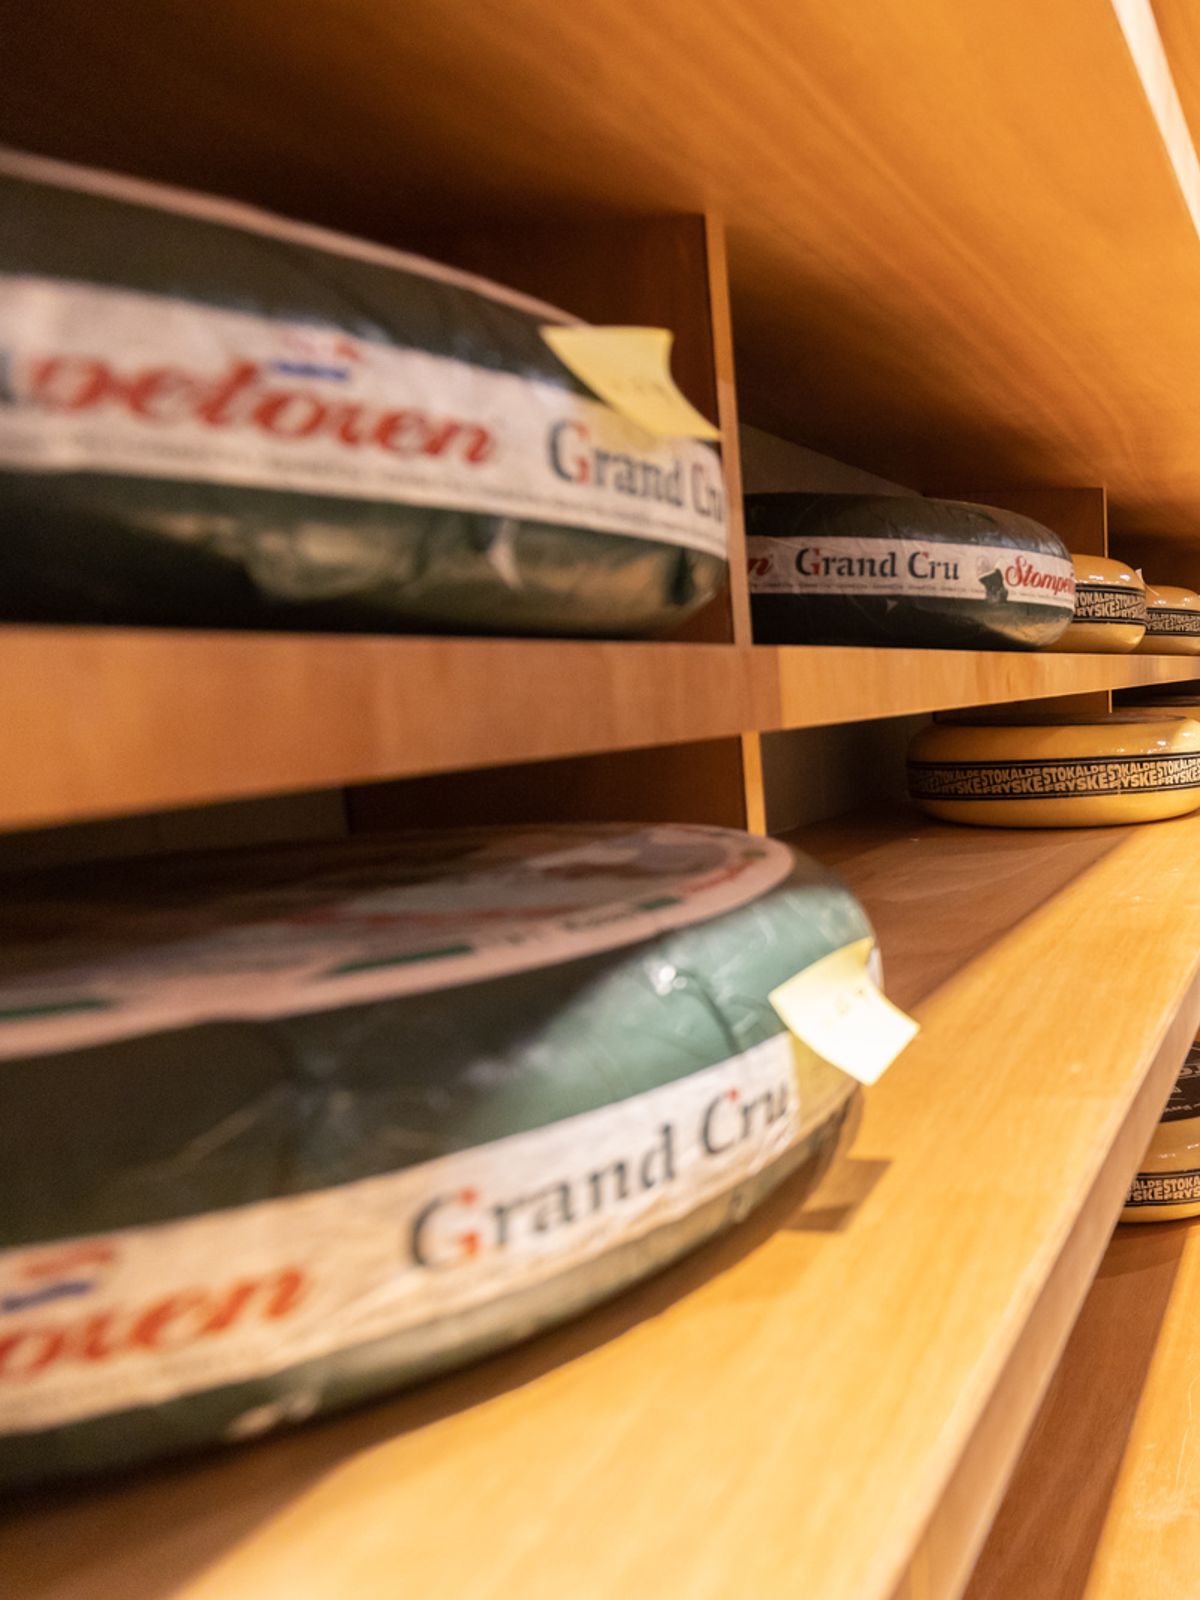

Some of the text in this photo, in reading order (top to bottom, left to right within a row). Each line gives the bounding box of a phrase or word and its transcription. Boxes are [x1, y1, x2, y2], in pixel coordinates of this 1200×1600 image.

[547, 418, 684, 508] Grand
[795, 548, 897, 577] Grand
[908, 552, 959, 580] Cru
[412, 1086, 790, 1270] Grand Cru
